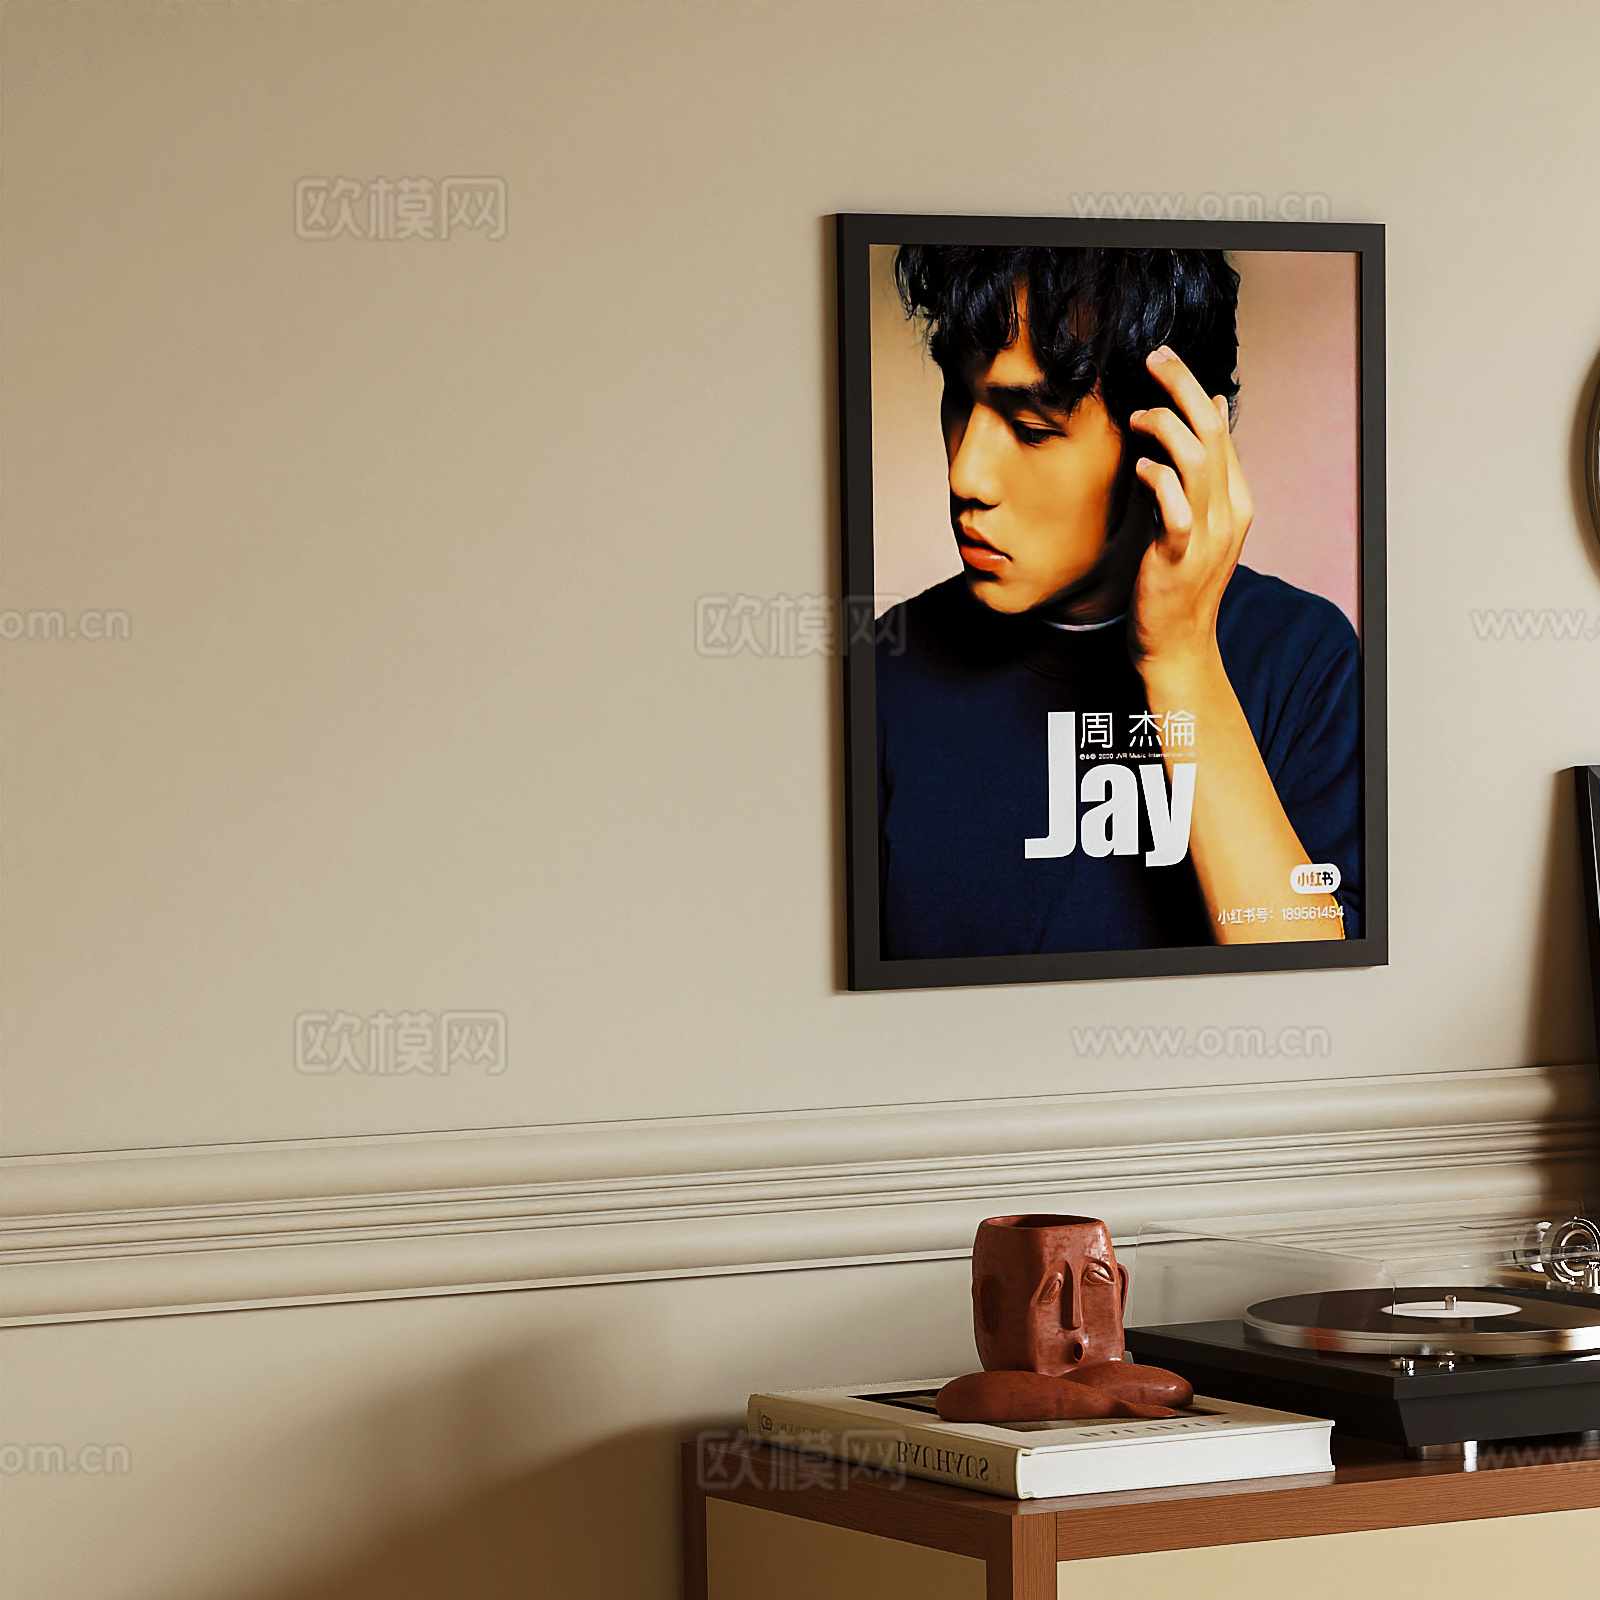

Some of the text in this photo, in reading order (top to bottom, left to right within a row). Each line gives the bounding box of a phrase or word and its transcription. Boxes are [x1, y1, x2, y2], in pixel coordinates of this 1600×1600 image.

[1025, 711, 1197, 867] Jay
[1298, 871, 1334, 887] 小红书
[1281, 905, 1345, 921] 189561454
